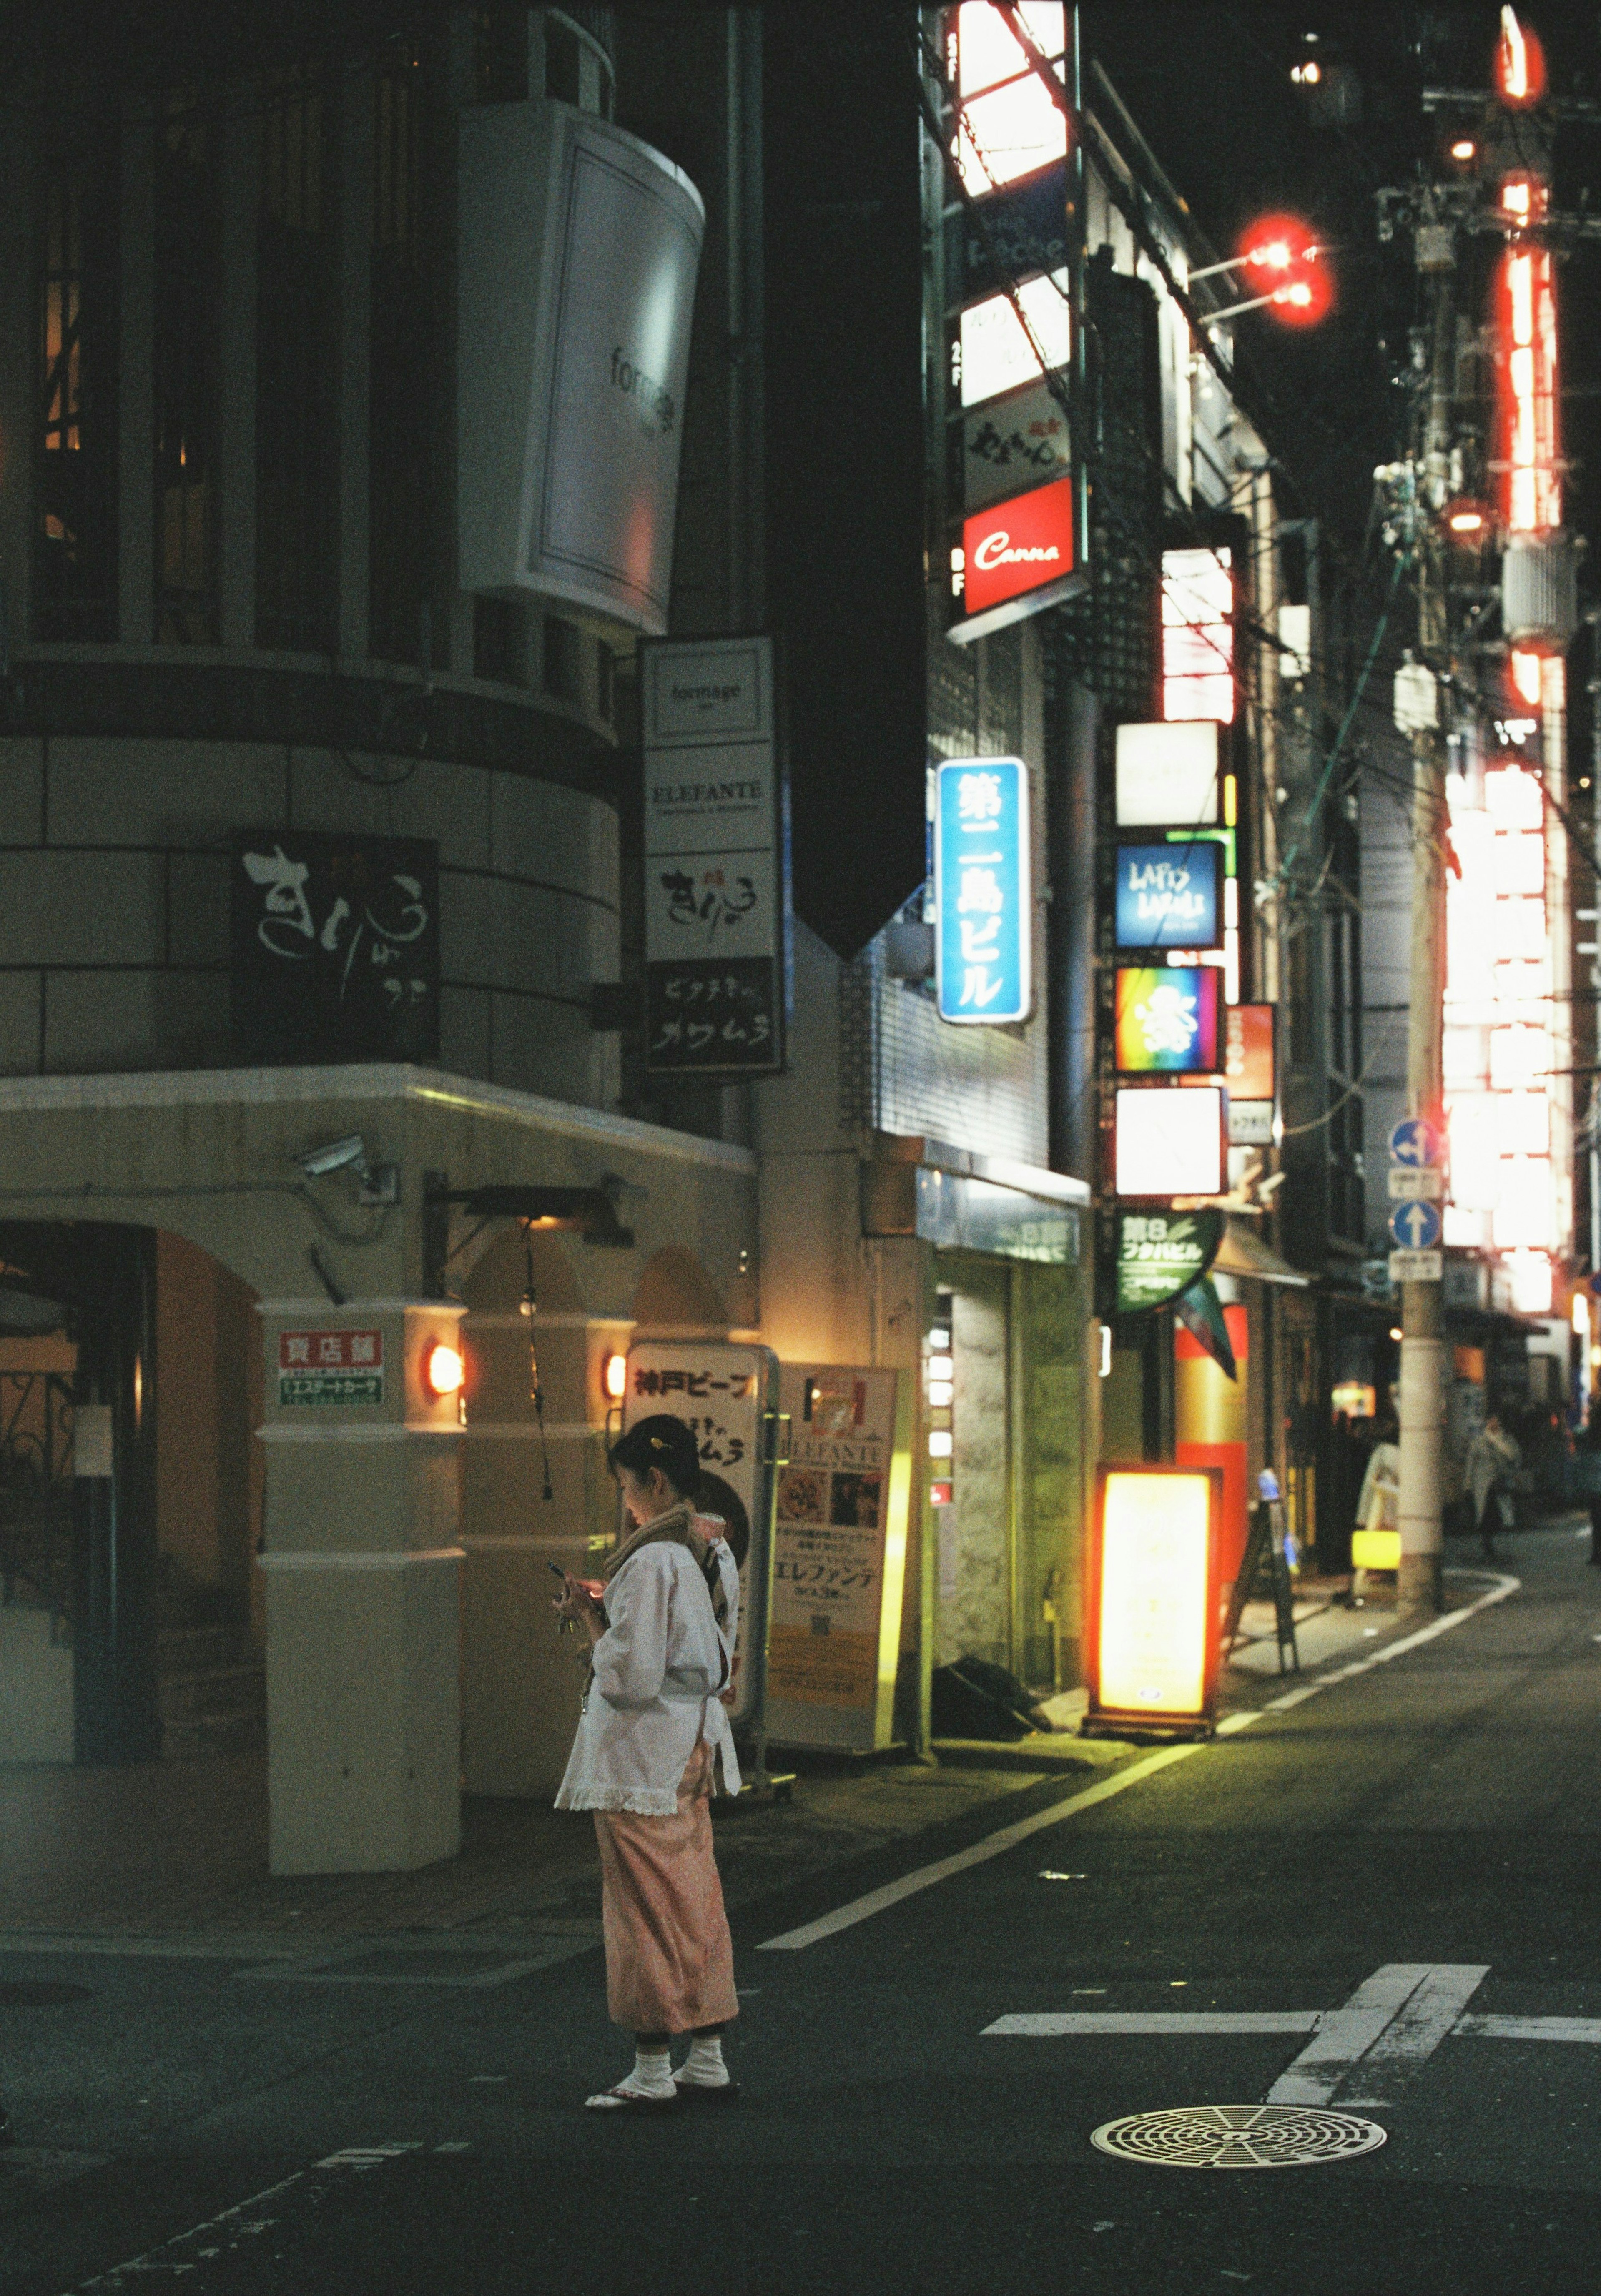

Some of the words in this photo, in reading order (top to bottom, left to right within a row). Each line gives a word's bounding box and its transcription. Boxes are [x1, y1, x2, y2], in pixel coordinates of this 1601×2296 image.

[974, 531, 1060, 571] Canna
[653, 781, 762, 803] ELEFANTE
[635, 1368, 751, 1398] 神戸ビーフ
